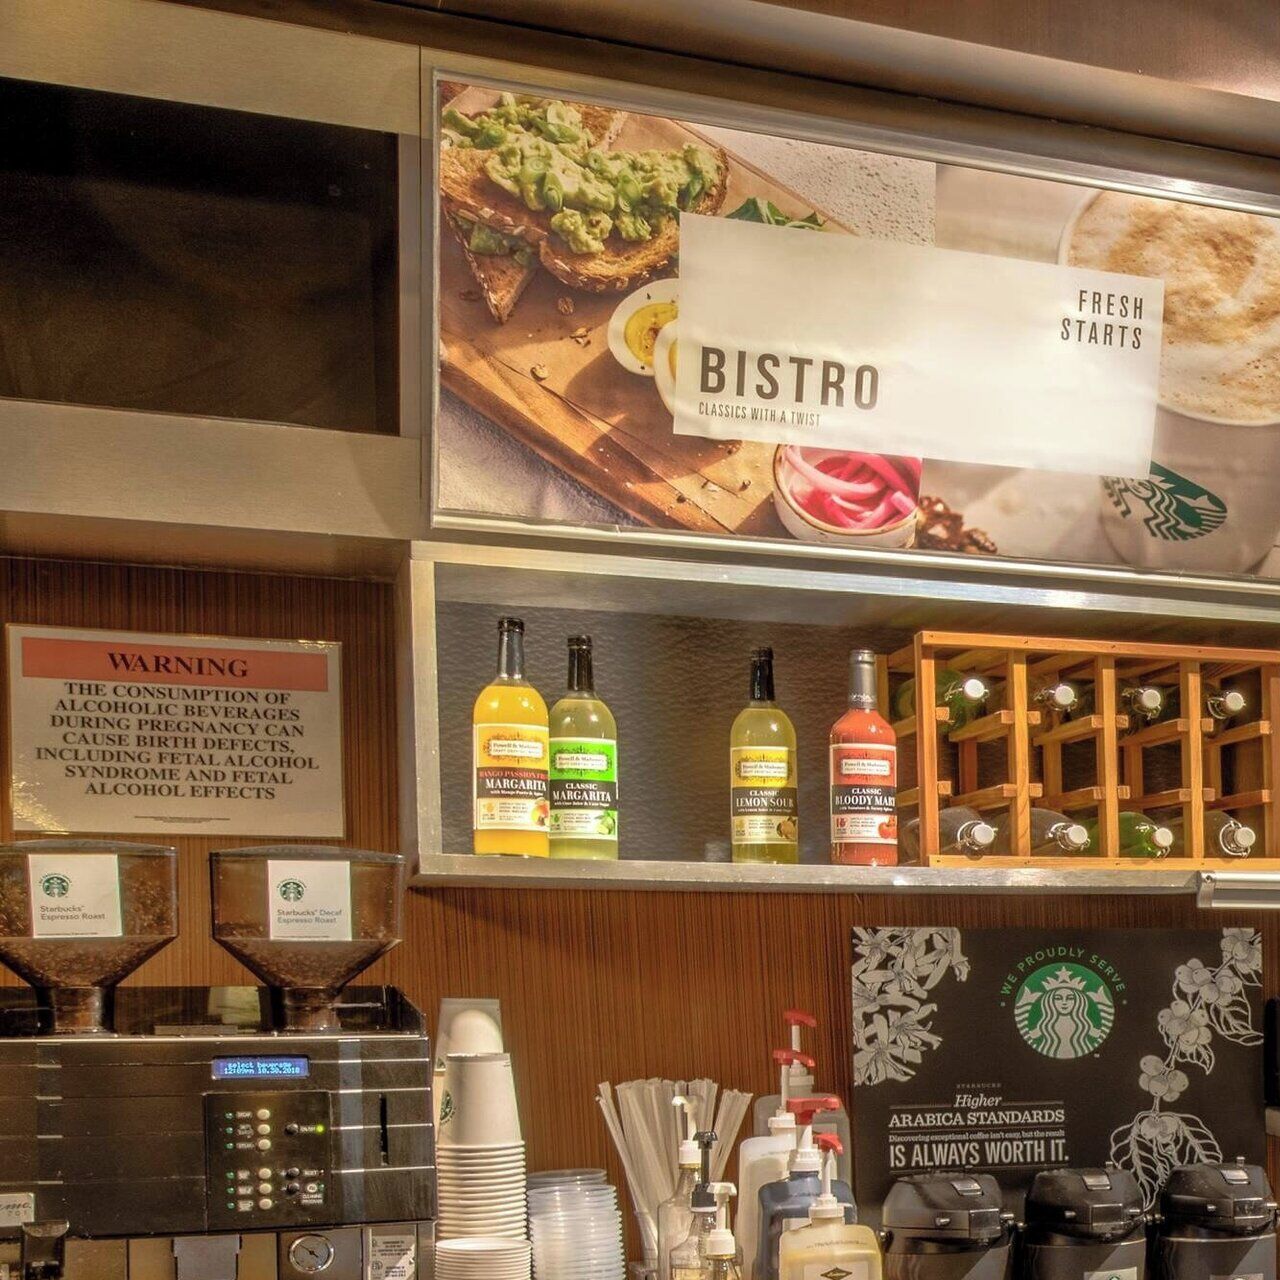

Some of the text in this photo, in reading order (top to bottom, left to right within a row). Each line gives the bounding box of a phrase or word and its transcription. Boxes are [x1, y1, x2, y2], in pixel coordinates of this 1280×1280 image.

[1079, 290, 1144, 320] FRESH
[1060, 317, 1142, 350] STARTS
[700, 346, 879, 410] BISTRO
[699, 402, 821, 427] CLASSICS WITH A TWIST
[108, 652, 248, 678] WARNING
[64, 682, 291, 704] THE CONSUMPTION OF
[56, 700, 300, 721] ALCOHOLIC BEVERAGES
[50, 715, 304, 738] DURING PREGNANCY CAN
[63, 732, 295, 754] CAUSE BIRTH DEFECTS,
[36, 748, 320, 770] INCLUDING FETAL ALCOHOL
[65, 766, 292, 784] SYNDROME AND FETAL
[485, 779, 546, 791] MARGARITA
[85, 782, 276, 800] ALCOHOL EFFECTS
[553, 791, 611, 802] MARGARITA
[836, 796, 873, 805] BLOODY
[736, 797, 794, 807] LEMON SOUR
[40, 912, 106, 921] Espresso Roast
[277, 916, 337, 925] Espresso Roast
[1001, 946, 1125, 995] WE PROUDLY SERVE
[953, 1093, 1002, 1109] Higher
[888, 1109, 1065, 1128] ARABICA STANDARDS
[890, 1139, 1069, 1168] IS ALWAYS WORTH IT.
